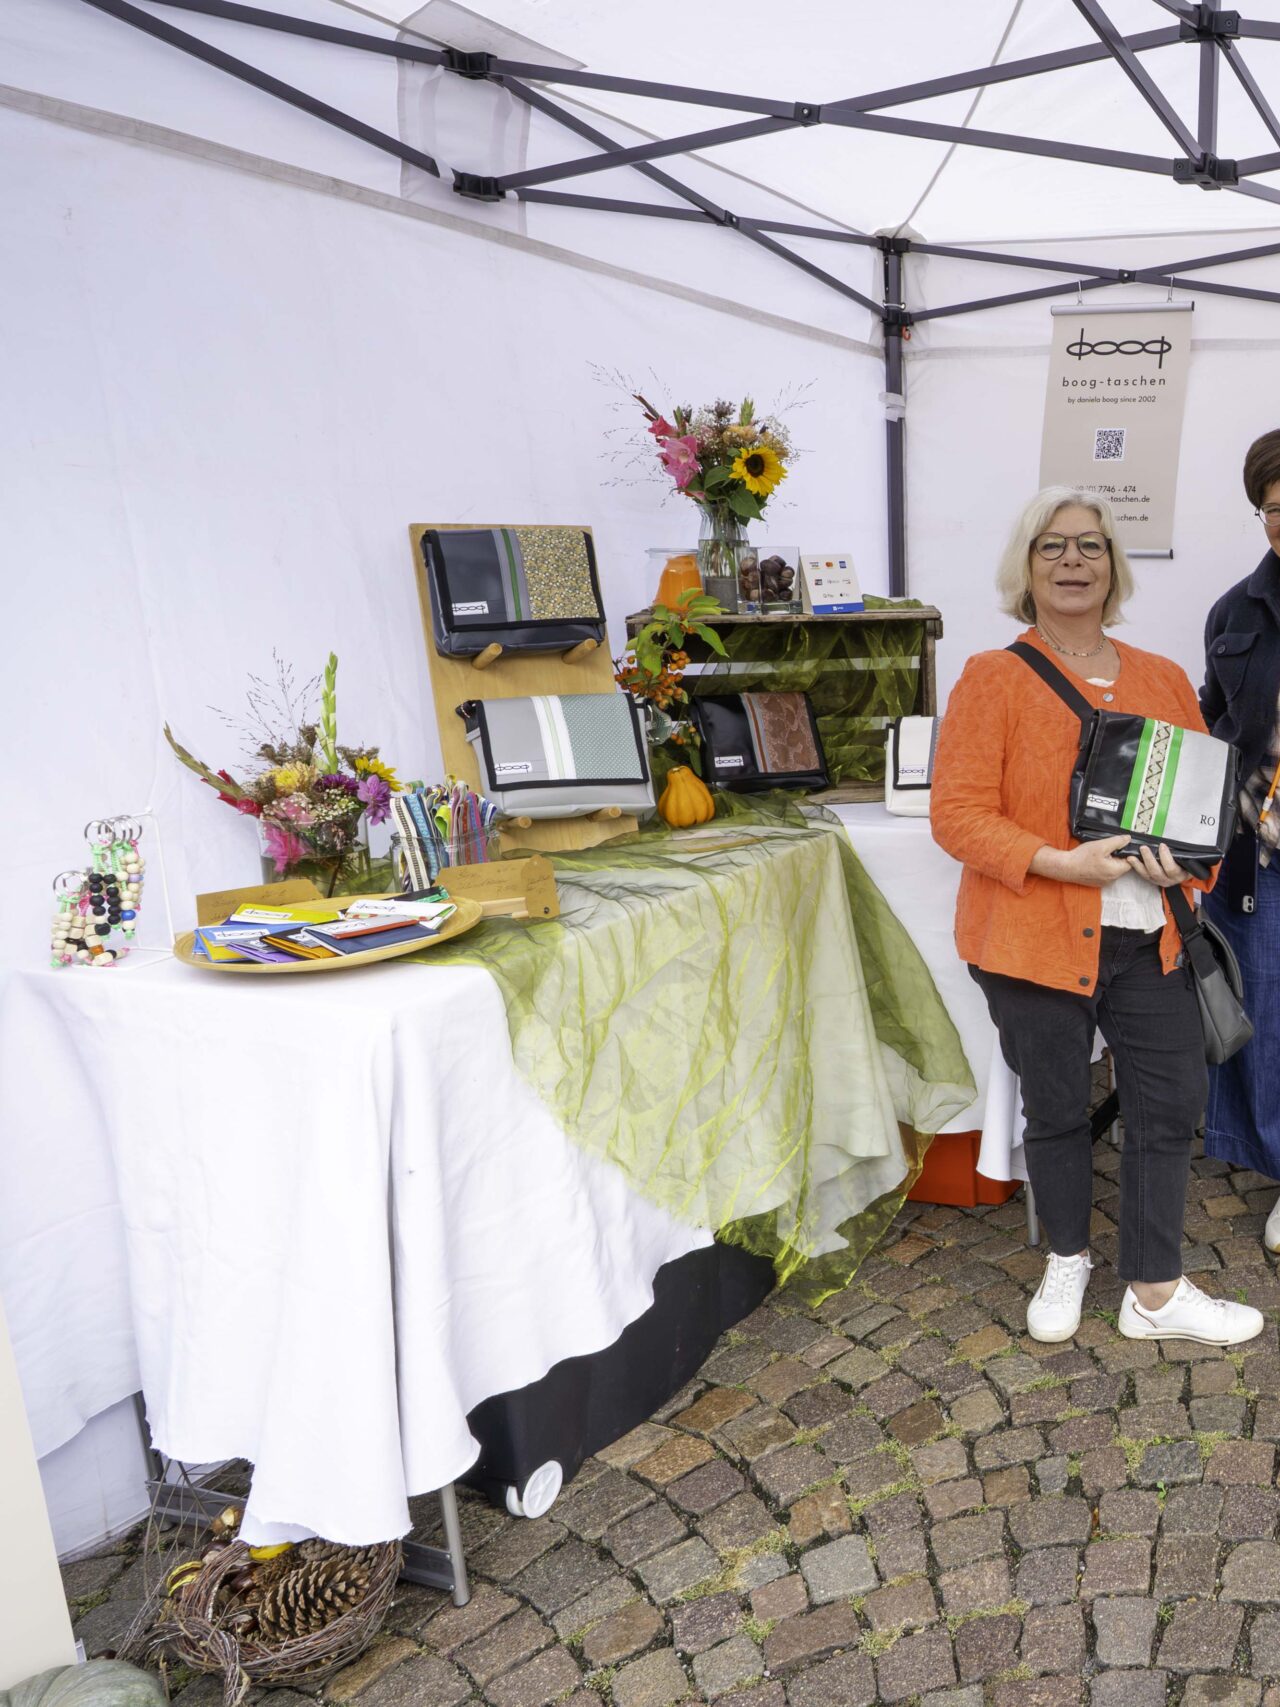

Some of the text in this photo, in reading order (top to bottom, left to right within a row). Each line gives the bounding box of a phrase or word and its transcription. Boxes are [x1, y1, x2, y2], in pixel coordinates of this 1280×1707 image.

[1062, 375, 1166, 389] boog-taschen
[1067, 396, 1075, 404] by
[1077, 395, 1100, 403] daniela
[1102, 396, 1118, 404] boog
[1138, 395, 1156, 403] 2002
[1098, 485, 1116, 493] 7746
[1123, 485, 1136, 493] 474
[1200, 815, 1215, 826] RO
